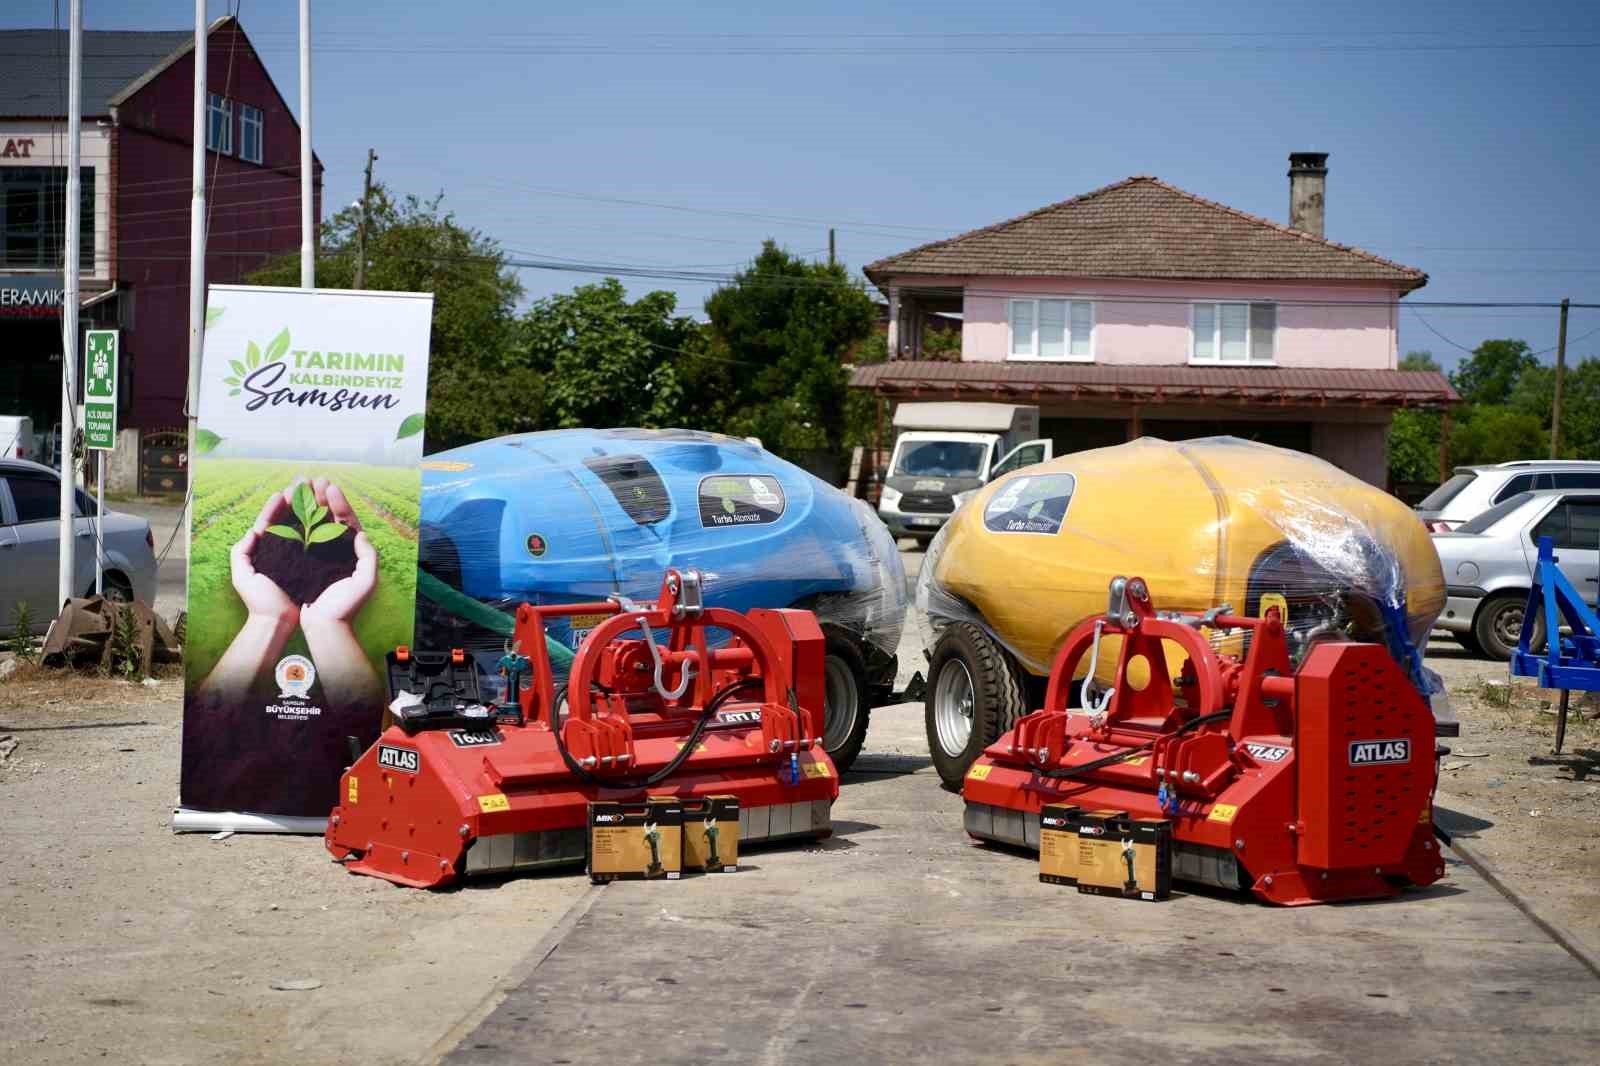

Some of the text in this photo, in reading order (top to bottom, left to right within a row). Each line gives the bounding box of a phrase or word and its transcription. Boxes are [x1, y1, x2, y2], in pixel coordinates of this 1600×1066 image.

[291, 350, 404, 372] TARIMIN
[243, 361, 400, 412] Samsun
[712, 514, 733, 524] Turbo
[1006, 519, 1025, 530] Turbo
[380, 748, 416, 769] ATLAS
[1354, 742, 1406, 762] ATLAS
